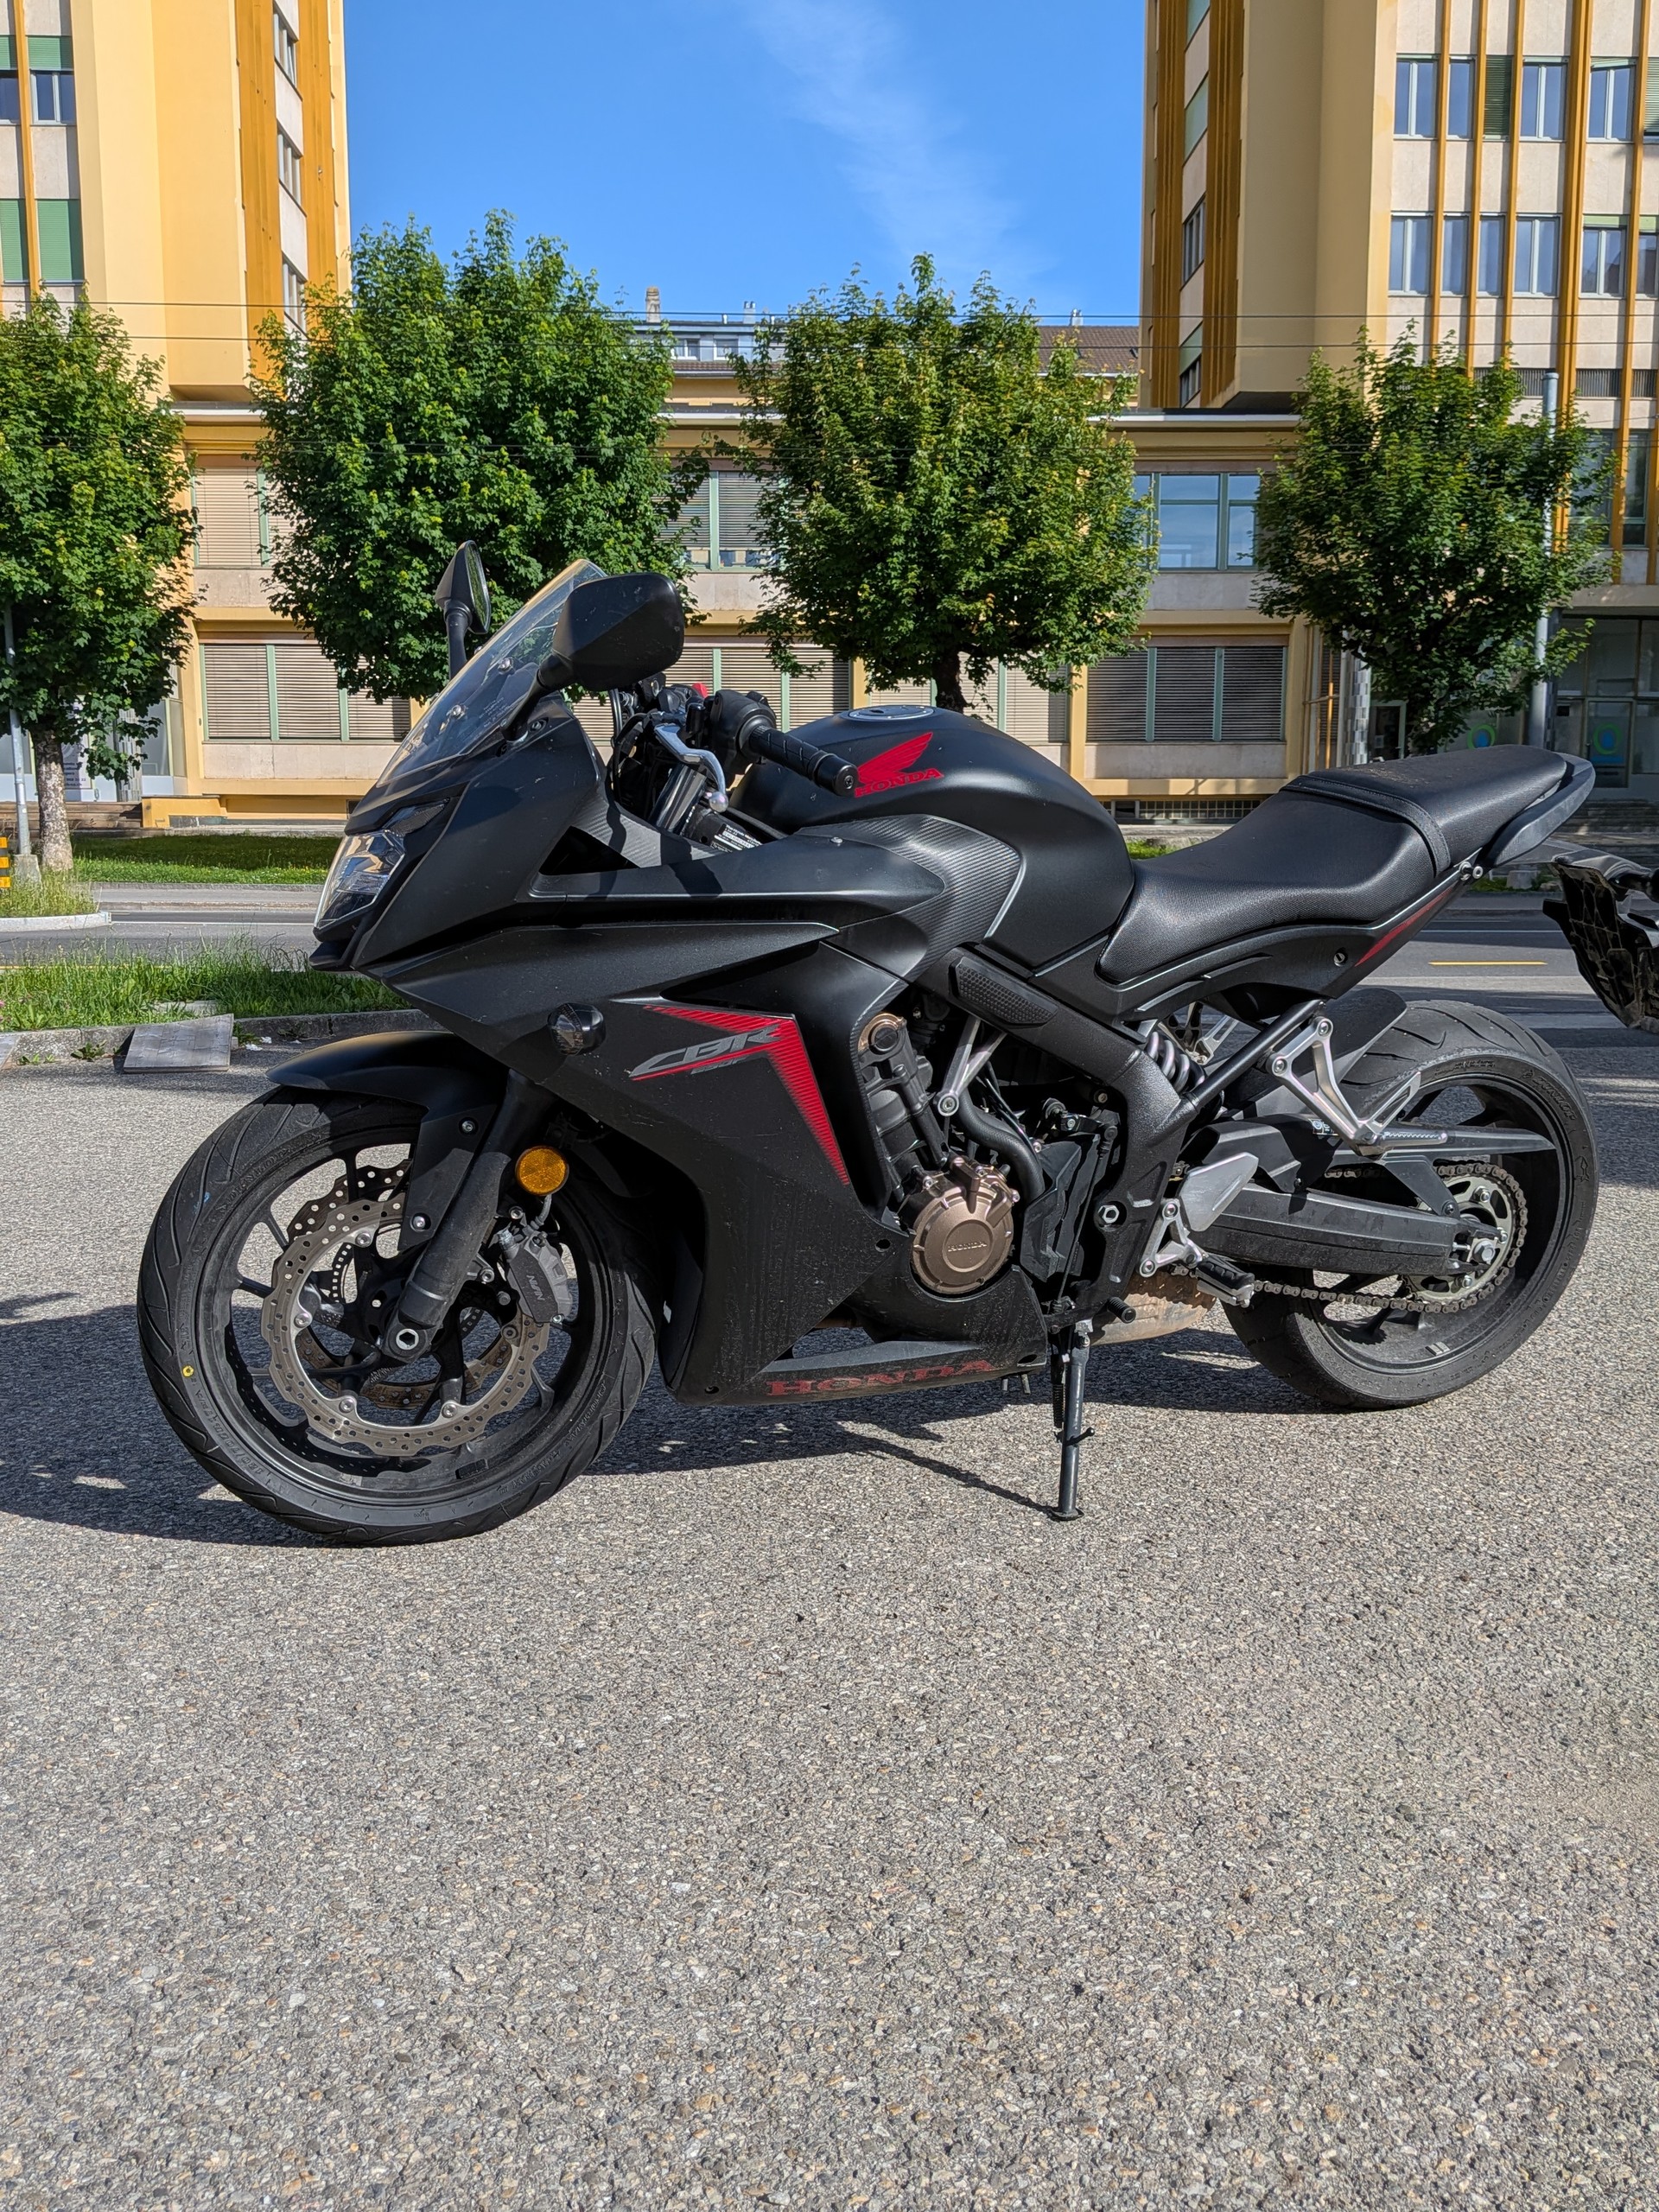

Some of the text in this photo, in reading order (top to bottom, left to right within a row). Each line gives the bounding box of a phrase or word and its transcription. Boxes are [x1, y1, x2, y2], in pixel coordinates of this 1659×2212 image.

[855, 768, 944, 798] HONDA
[629, 1023, 781, 1077] CBR
[947, 1241, 988, 1252] HONDA
[767, 1359, 994, 1396] HONDA
